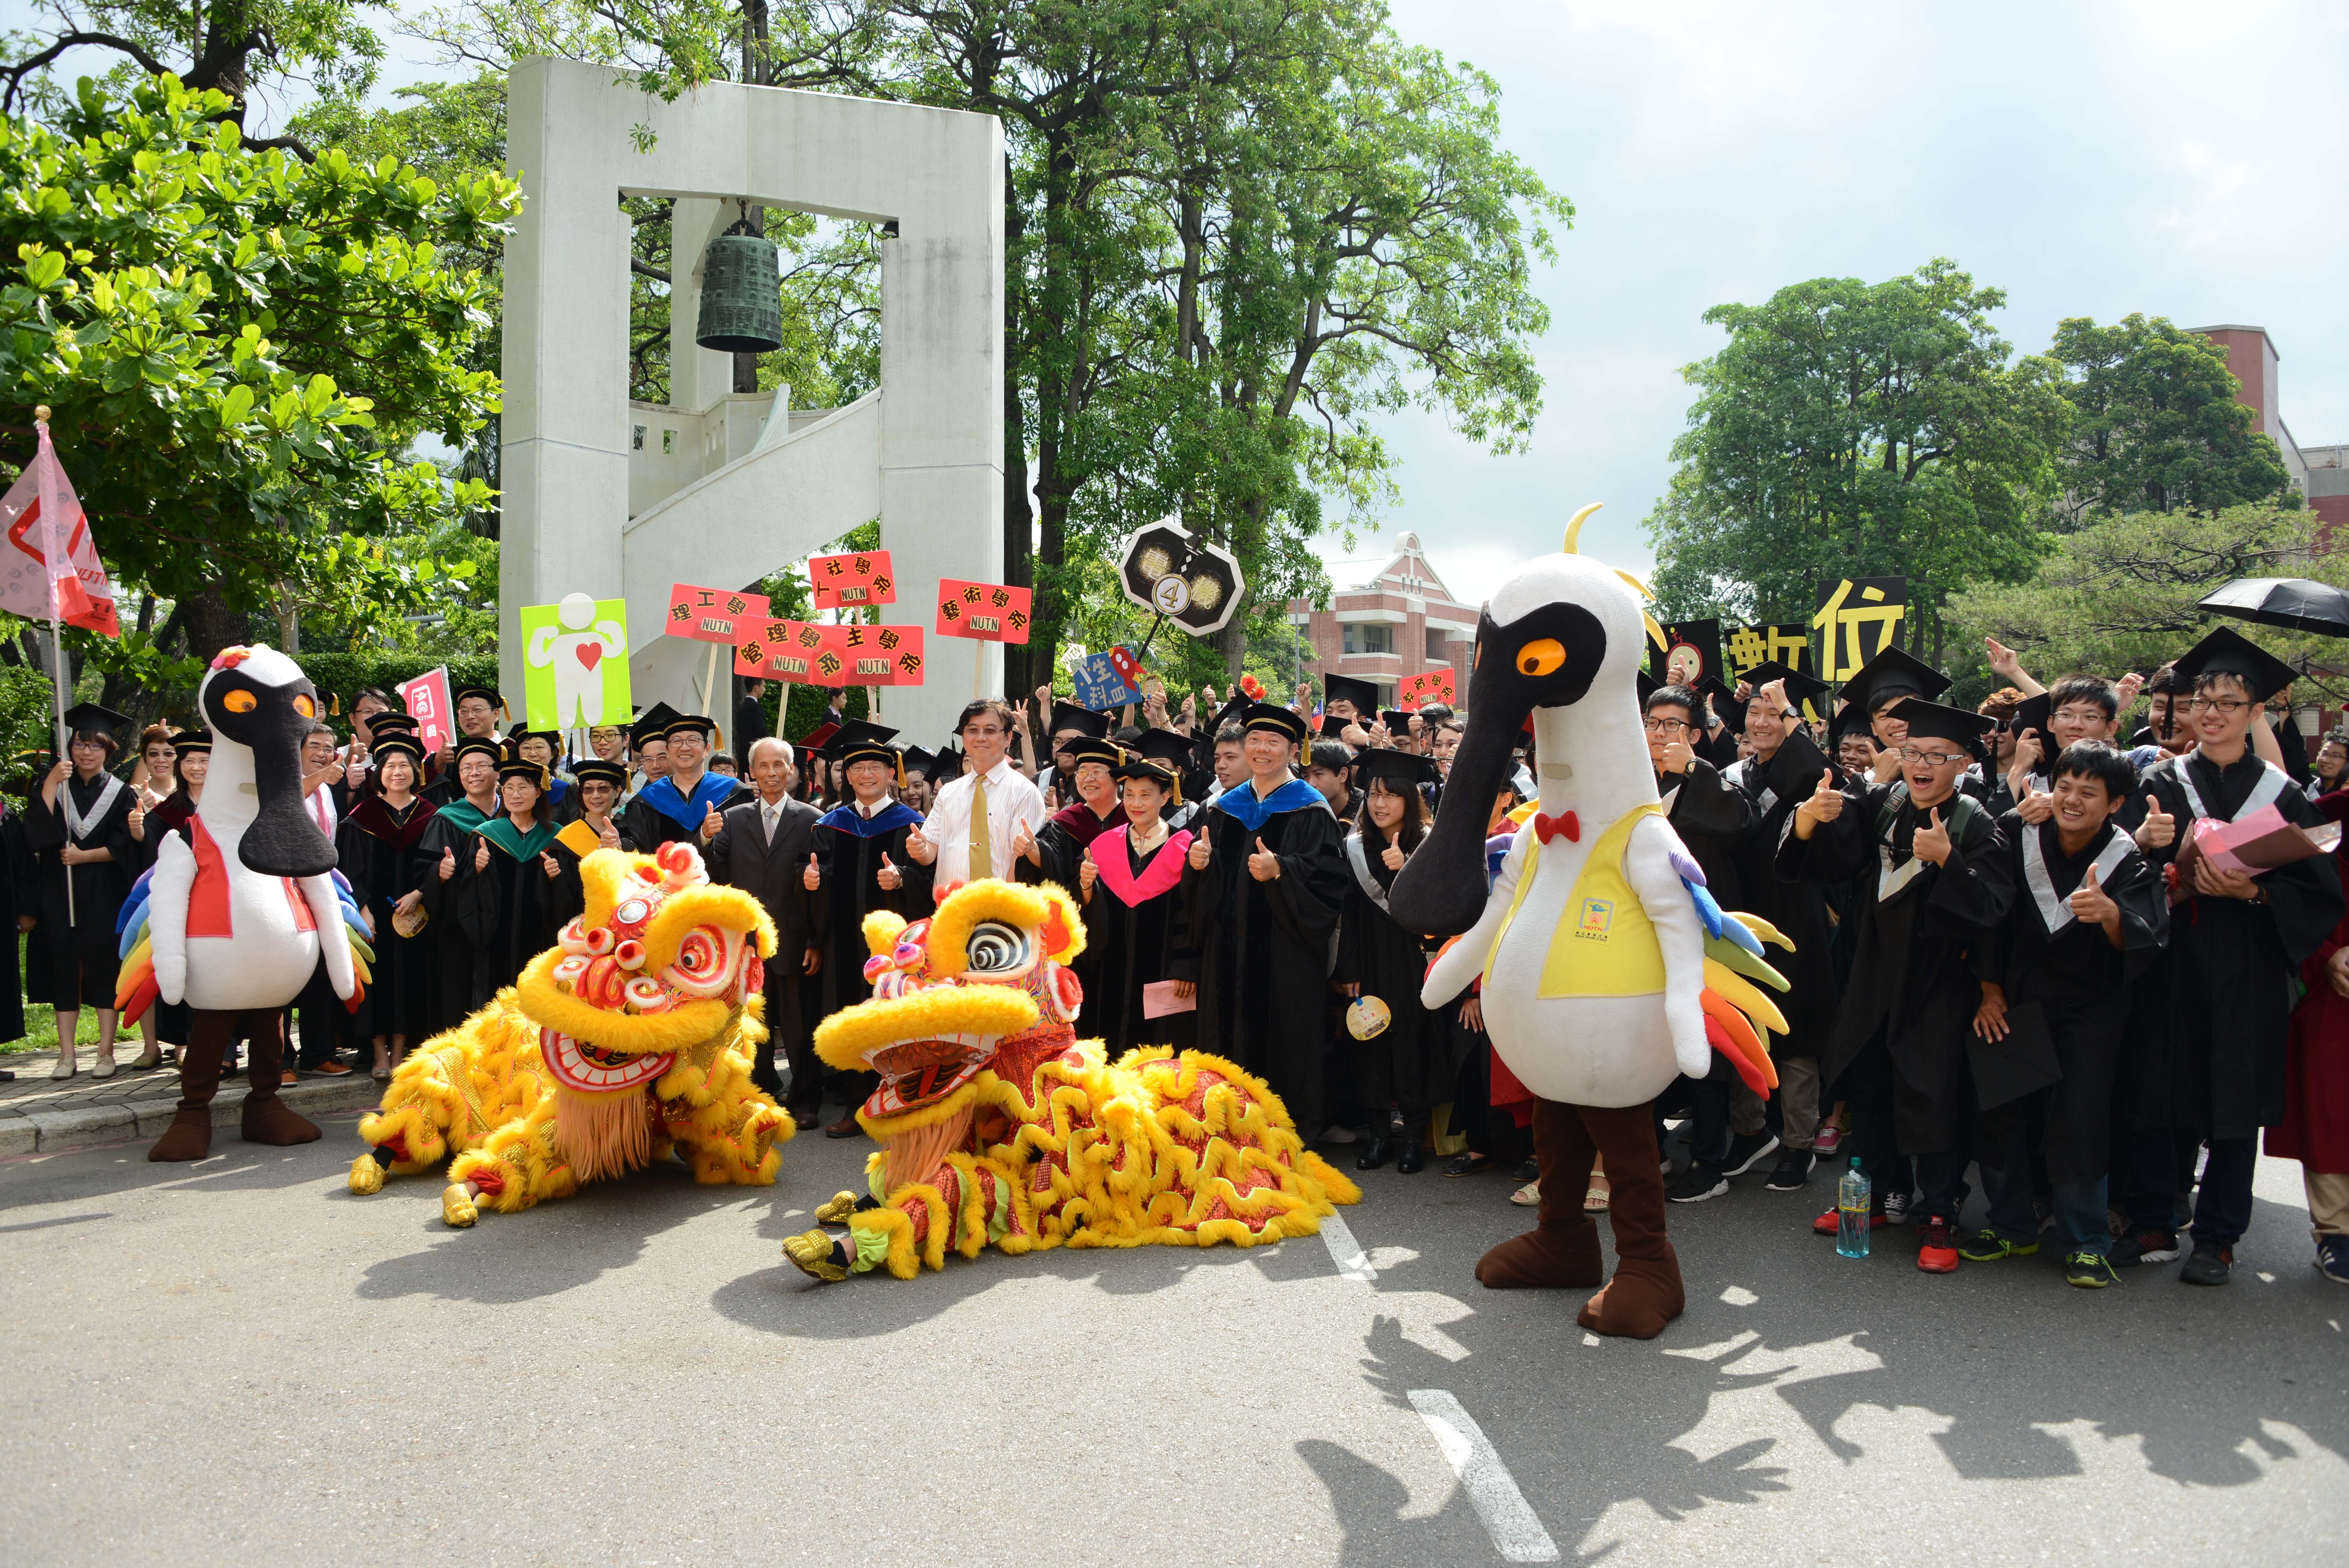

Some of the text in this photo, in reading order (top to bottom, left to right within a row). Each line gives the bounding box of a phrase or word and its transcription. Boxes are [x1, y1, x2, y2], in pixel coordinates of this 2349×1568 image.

[817, 556, 891, 597] 人社學院
[841, 586, 867, 601] NUTN
[1160, 582, 1179, 608] 4
[940, 586, 1028, 631] 藝術學院
[701, 617, 732, 634] NUTN
[970, 615, 999, 631] NUTN
[1813, 579, 1904, 682] 位
[740, 623, 841, 677] 管理學院
[1062, 646, 1081, 667] NUTN
[774, 655, 807, 673] NUTN
[857, 659, 890, 674] NUTN
[1069, 654, 1085, 672] BST
[1093, 658, 1112, 683] 生
[1403, 674, 1453, 704] 教育學院
[1420, 693, 1437, 704] NUTN
